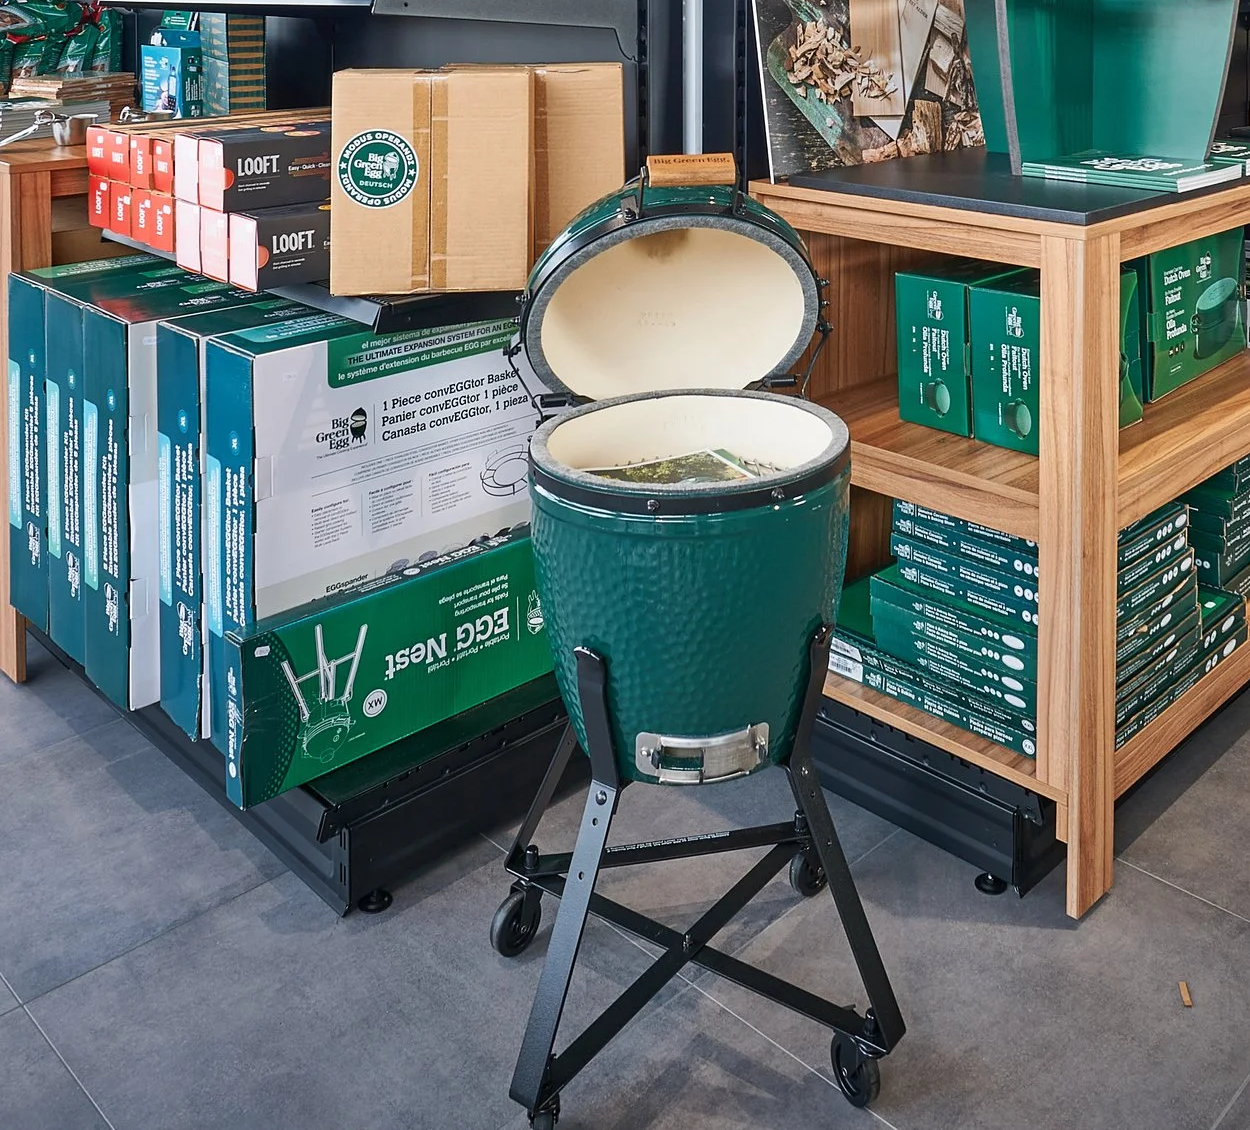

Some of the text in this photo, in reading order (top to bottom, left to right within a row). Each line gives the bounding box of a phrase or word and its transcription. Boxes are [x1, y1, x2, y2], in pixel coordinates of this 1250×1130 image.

[343, 132, 415, 166] MODUS OPERANDI
[237, 155, 280, 176] LOOFT
[354, 159, 383, 170] Green
[368, 153, 384, 164] Big
[364, 168, 382, 180] Egg
[341, 173, 413, 206] MODUS OPERANDI
[360, 180, 393, 188] DEUTSCH
[272, 230, 316, 254] LOOFT
[348, 356, 364, 366] THE
[366, 346, 402, 362] ULTIMATE
[404, 336, 446, 353] EXPANSION
[447, 330, 476, 343] SYSTEM
[476, 328, 490, 336] FOR
[492, 326, 502, 334] AN
[370, 337, 391, 348] mejor
[393, 330, 420, 342] sistema
[348, 366, 378, 379] système
[380, 356, 420, 370] d'extension
[420, 352, 430, 360] du
[432, 346, 463, 359] barbecue
[464, 341, 479, 350] EGG
[480, 338, 491, 348] par
[492, 333, 511, 344] excell
[383, 400, 388, 412] 1
[392, 394, 422, 410] Piece
[424, 378, 485, 401] convEGGtor
[382, 383, 518, 427] Panier convEGGtor 1 pièce
[332, 415, 349, 430] Big
[382, 394, 529, 442] Canasta convEGGtor, 1 pieza
[316, 426, 349, 446] Green
[329, 436, 350, 450] Egg
[326, 572, 369, 594] EGGspander
[462, 580, 490, 596] transporte
[492, 585, 501, 594] plie
[438, 593, 456, 605] pliega
[454, 594, 478, 609] transport
[478, 588, 491, 598] pour
[494, 592, 509, 602] Folds
[455, 600, 486, 617] transporting
[385, 606, 510, 680] EGG Nest
[428, 632, 510, 674] Portable Portatif Portátil
[368, 696, 382, 710] MX
